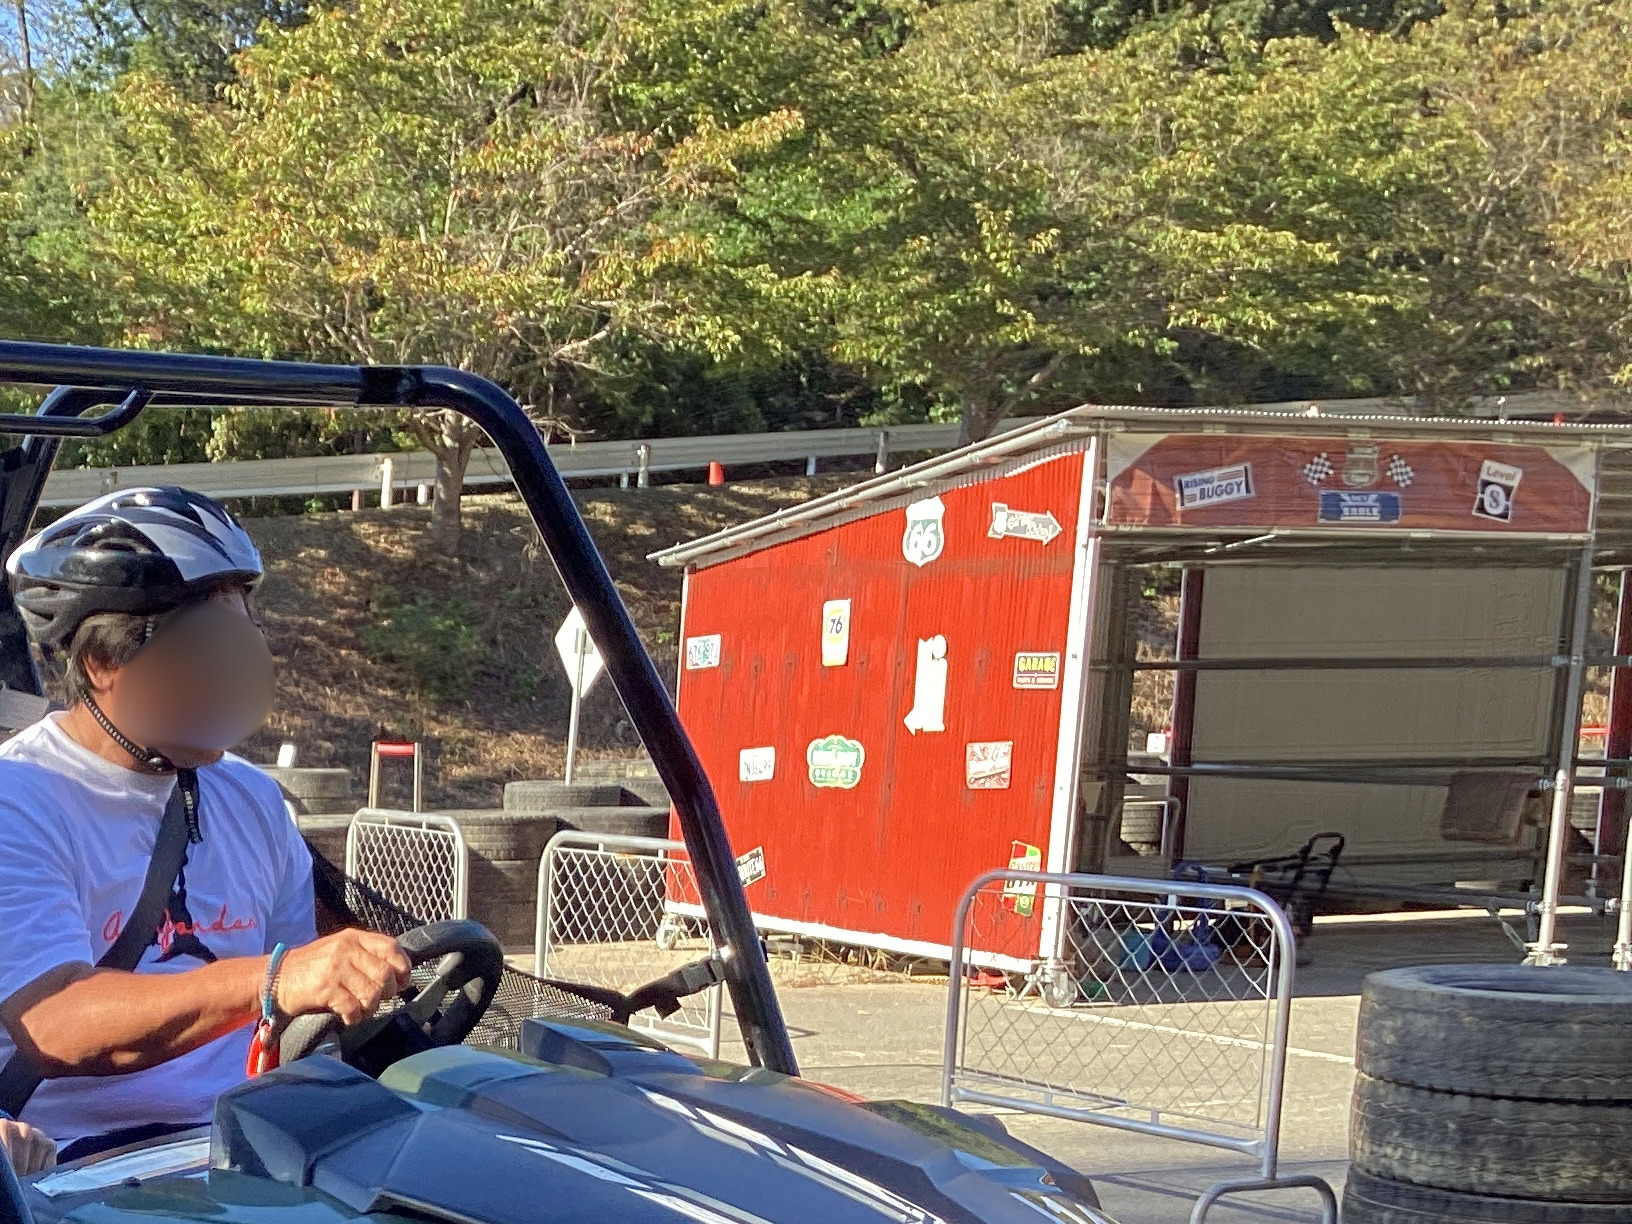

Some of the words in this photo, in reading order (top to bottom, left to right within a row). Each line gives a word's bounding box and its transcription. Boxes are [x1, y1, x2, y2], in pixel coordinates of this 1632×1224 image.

[1183, 475, 1215, 489] RISING
[1199, 479, 1243, 501] BUGGY
[908, 521, 938, 558] 66
[829, 616, 843, 635] 76
